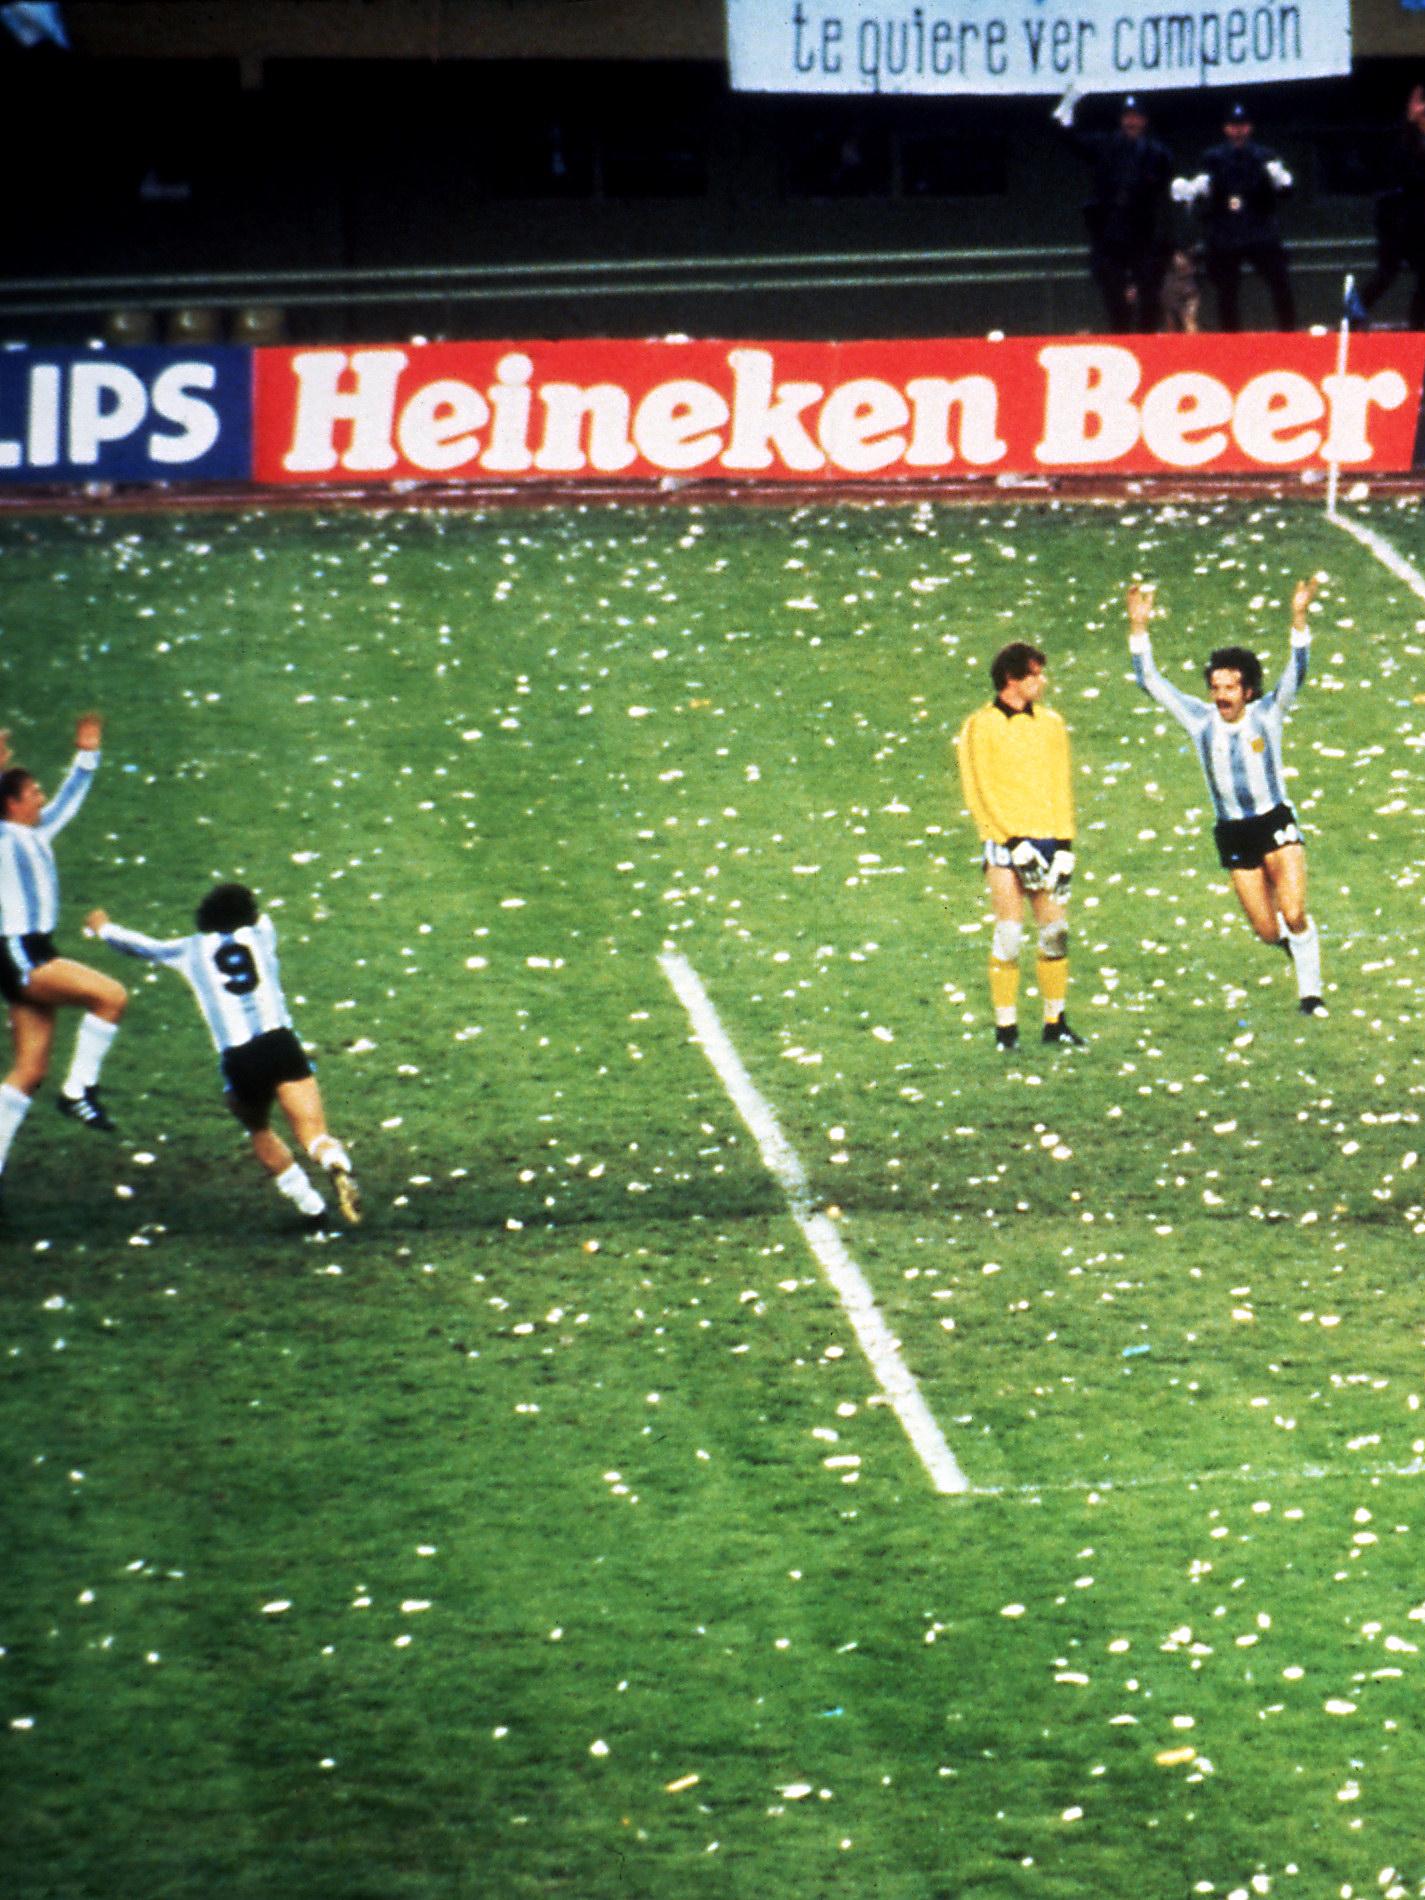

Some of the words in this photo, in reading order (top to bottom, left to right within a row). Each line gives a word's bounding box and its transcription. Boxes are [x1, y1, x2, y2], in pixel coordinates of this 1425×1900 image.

[793, 1, 843, 73] te
[858, 7, 1008, 94] quiere
[1022, 17, 1095, 74] ver
[283, 347, 1007, 473] Heineken
[1035, 343, 1409, 467] Beer
[214, 943, 259, 995] 9
